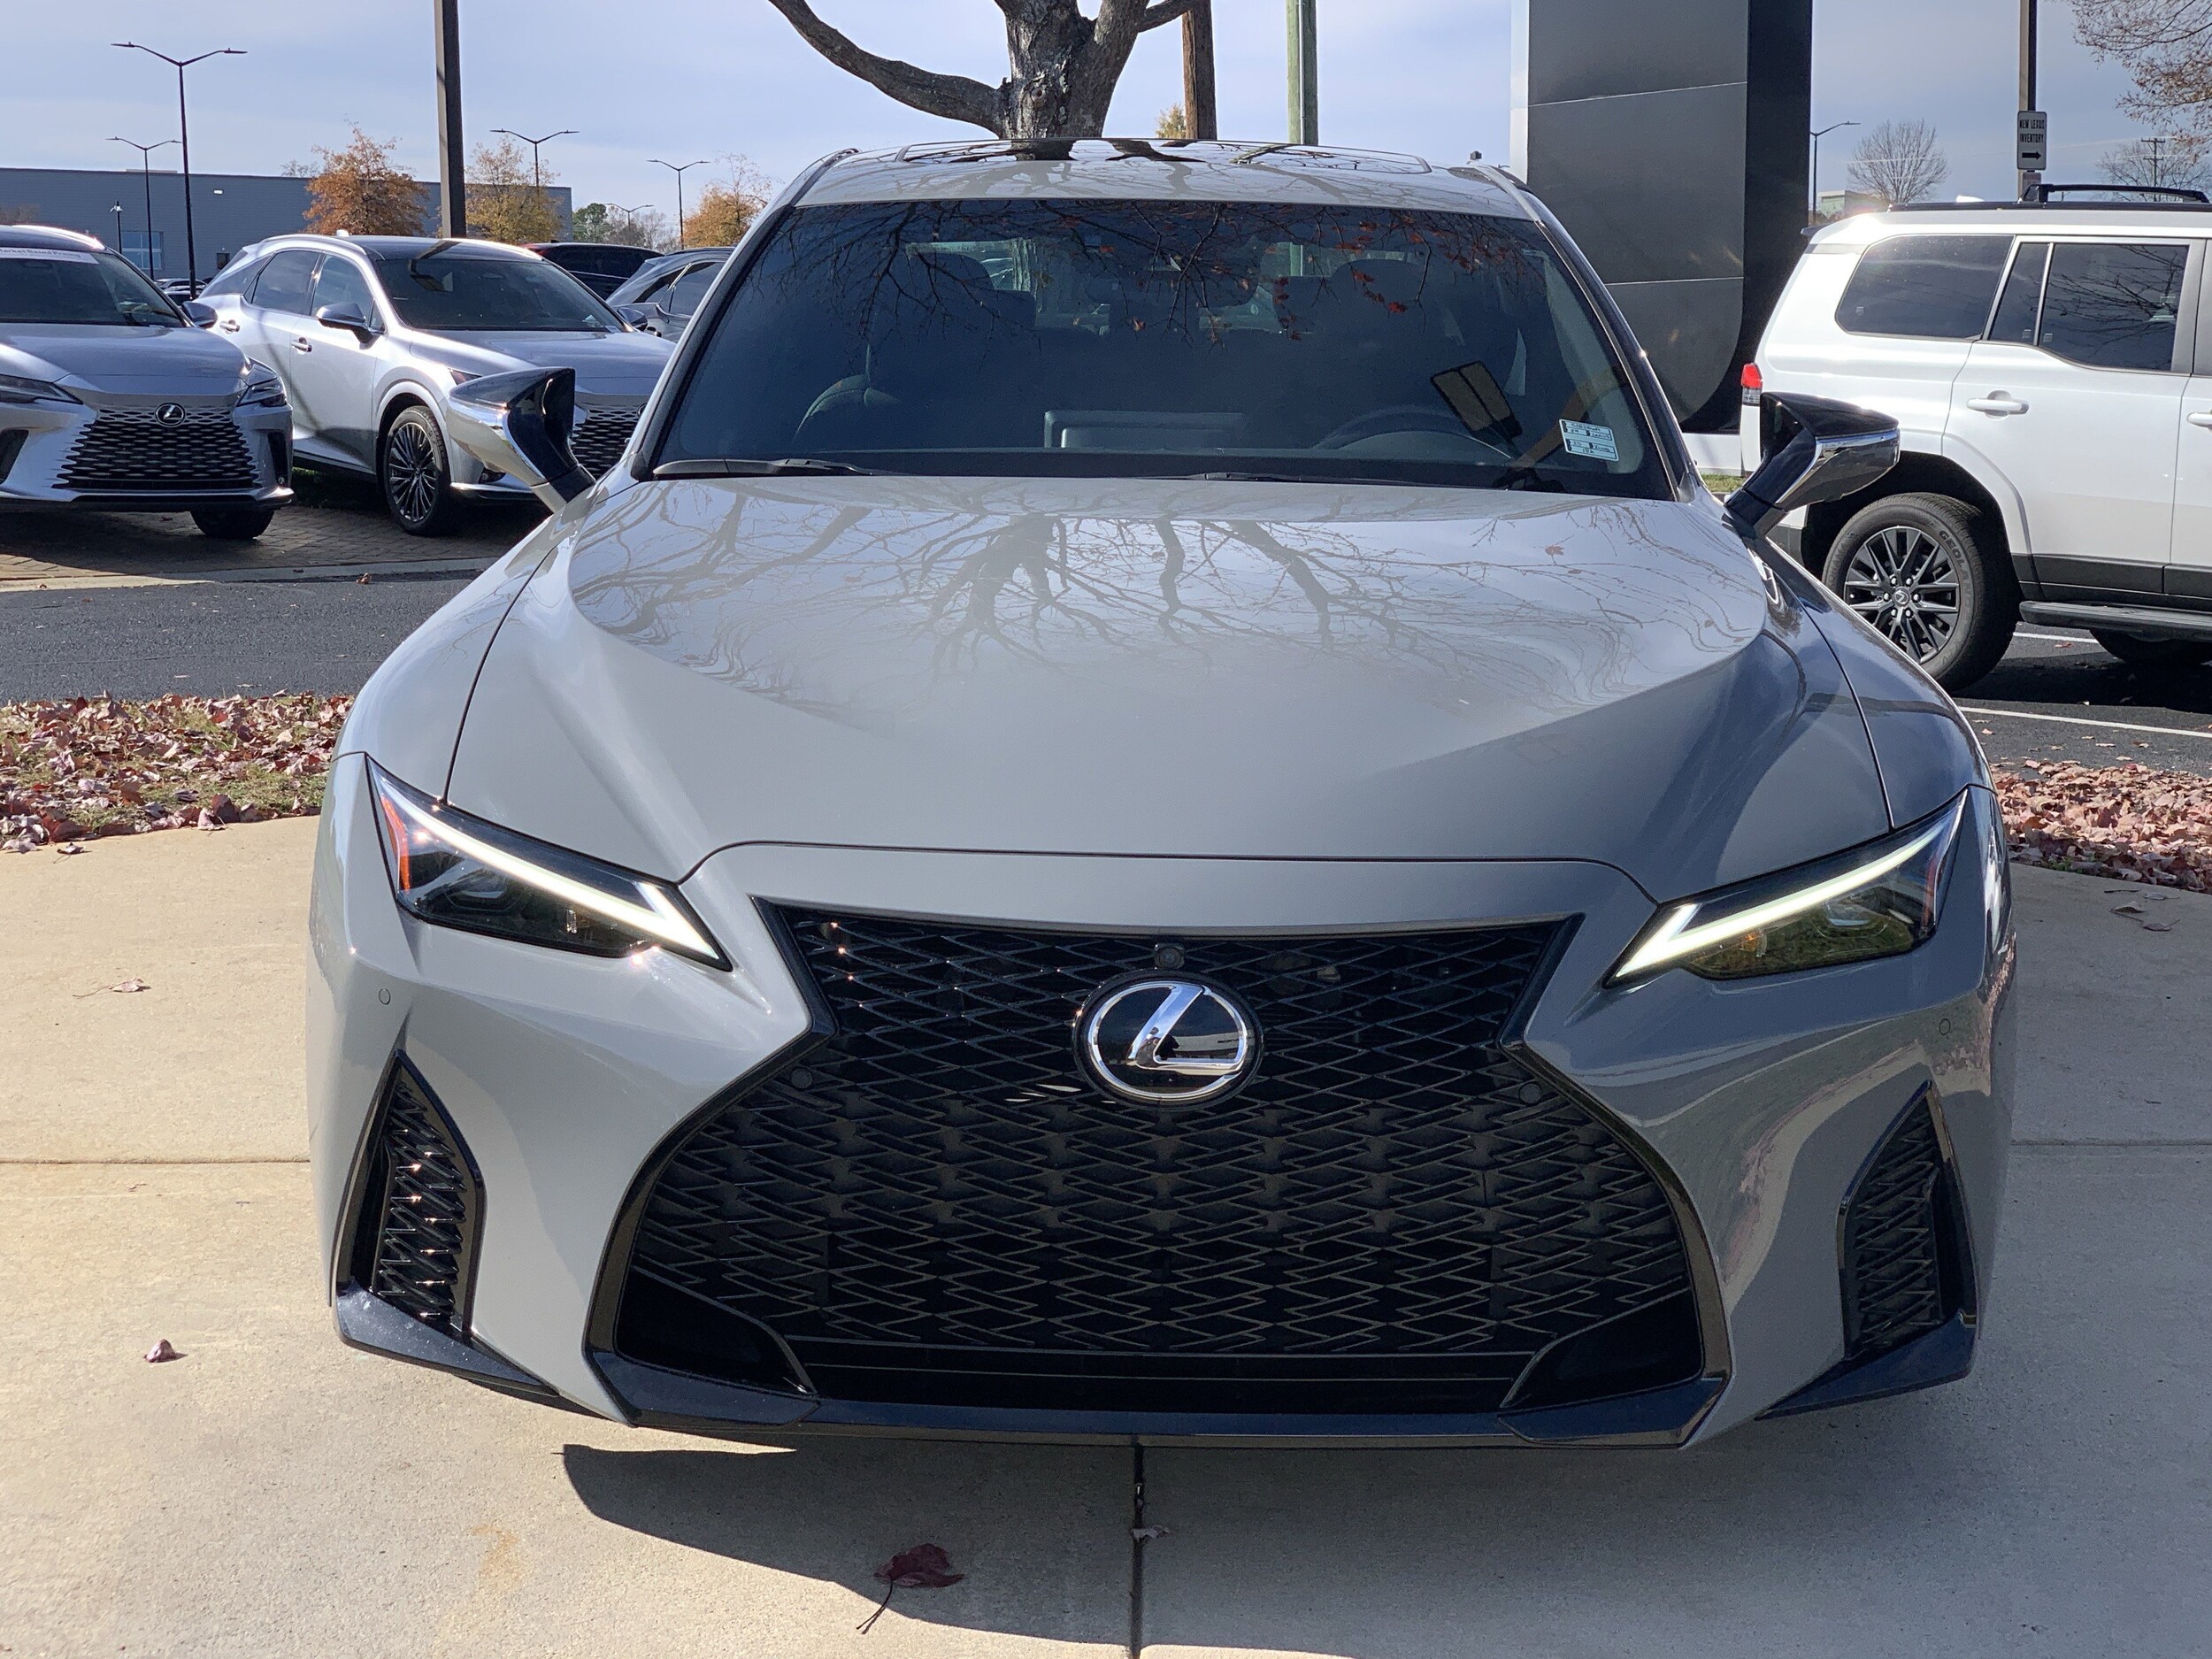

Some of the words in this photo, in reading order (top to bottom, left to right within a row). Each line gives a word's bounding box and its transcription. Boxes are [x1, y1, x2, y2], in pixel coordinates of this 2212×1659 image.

[2019, 119, 2029, 129] NEW
[2031, 119, 2045, 129] LEXUS
[2019, 134, 2044, 143] INVENTORY
